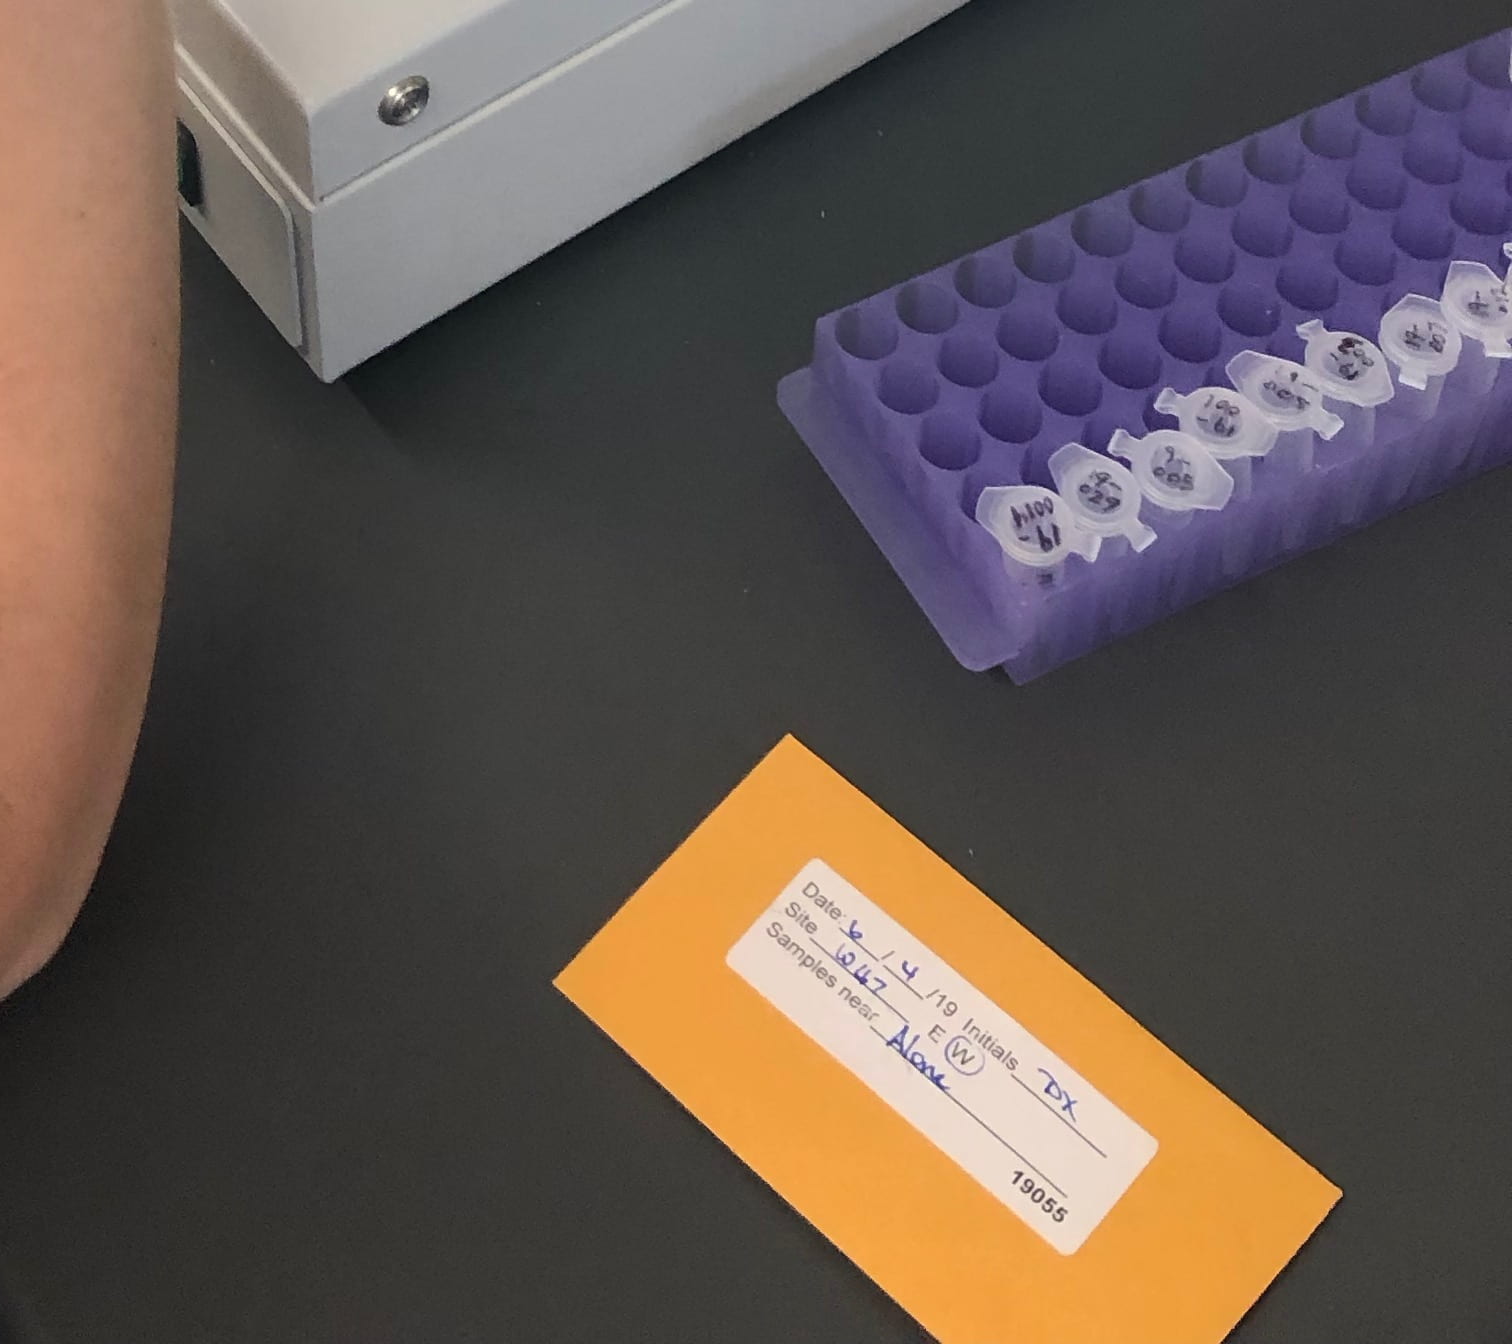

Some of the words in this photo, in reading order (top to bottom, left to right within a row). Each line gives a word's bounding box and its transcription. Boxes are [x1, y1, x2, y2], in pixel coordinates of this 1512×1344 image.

[766, 921, 838, 989] Samples
[838, 986, 880, 1022] near
[784, 901, 818, 935] Site
[927, 1024, 946, 1044] E
[951, 1042, 976, 1066] W
[802, 881, 847, 924] Date:
[849, 919, 863, 940] 6
[901, 960, 919, 983] 4
[962, 1018, 1019, 1071] Initials
[1012, 1169, 1069, 1224] 19055
